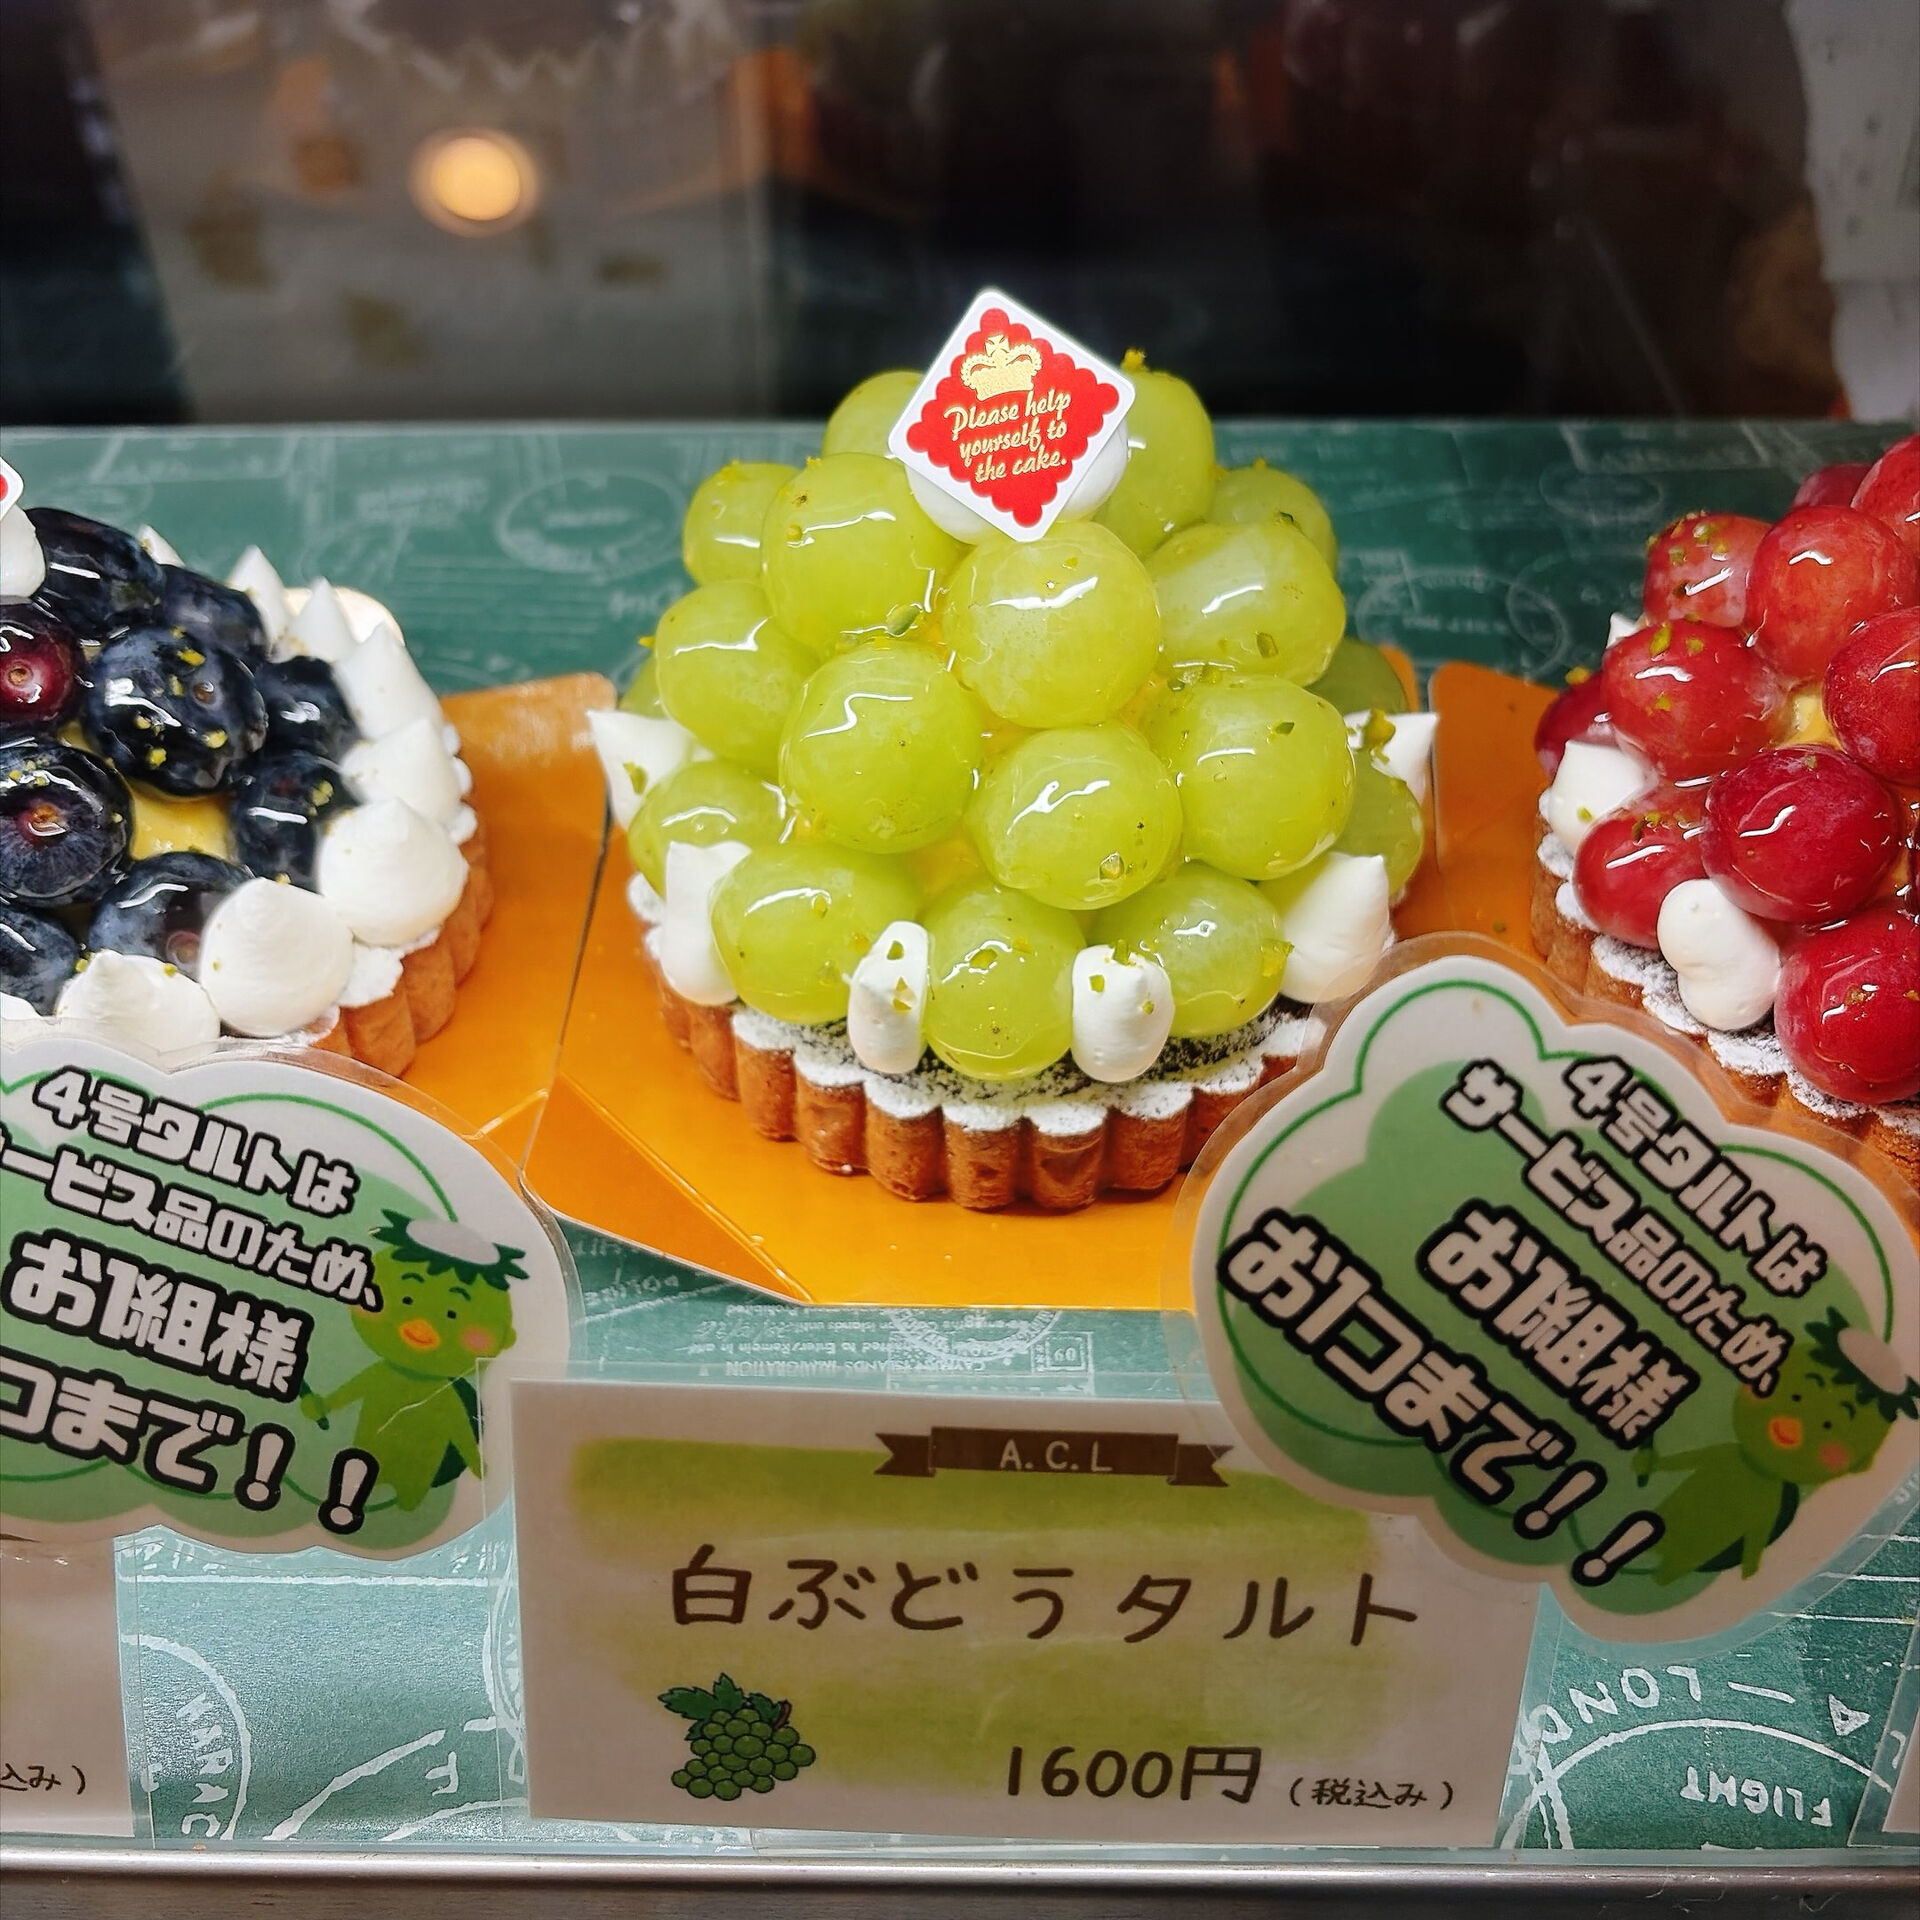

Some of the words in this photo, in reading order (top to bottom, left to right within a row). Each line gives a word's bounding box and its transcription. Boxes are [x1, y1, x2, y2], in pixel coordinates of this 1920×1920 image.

[943, 406, 1019, 441] Please
[1025, 388, 1071, 420] help
[959, 417, 1043, 468] yourself
[1047, 420, 1068, 440] to
[975, 456, 1007, 483] the
[1012, 449, 1068, 475] cake.
[33, 1065, 361, 1217] 4号タルトは
[1561, 1055, 1828, 1298] 4号タルトは
[0, 1125, 384, 1314] ービス品のため、
[1439, 1058, 1794, 1396] サービス品のため、
[5, 1227, 315, 1403] お1組様
[1417, 1198, 1700, 1448] お1組様
[672, 1544, 1418, 1646] 白ぶどうタルト
[1007, 1745, 1262, 1803] 1600円
[1680, 1766, 1833, 1828] FLIGHT
